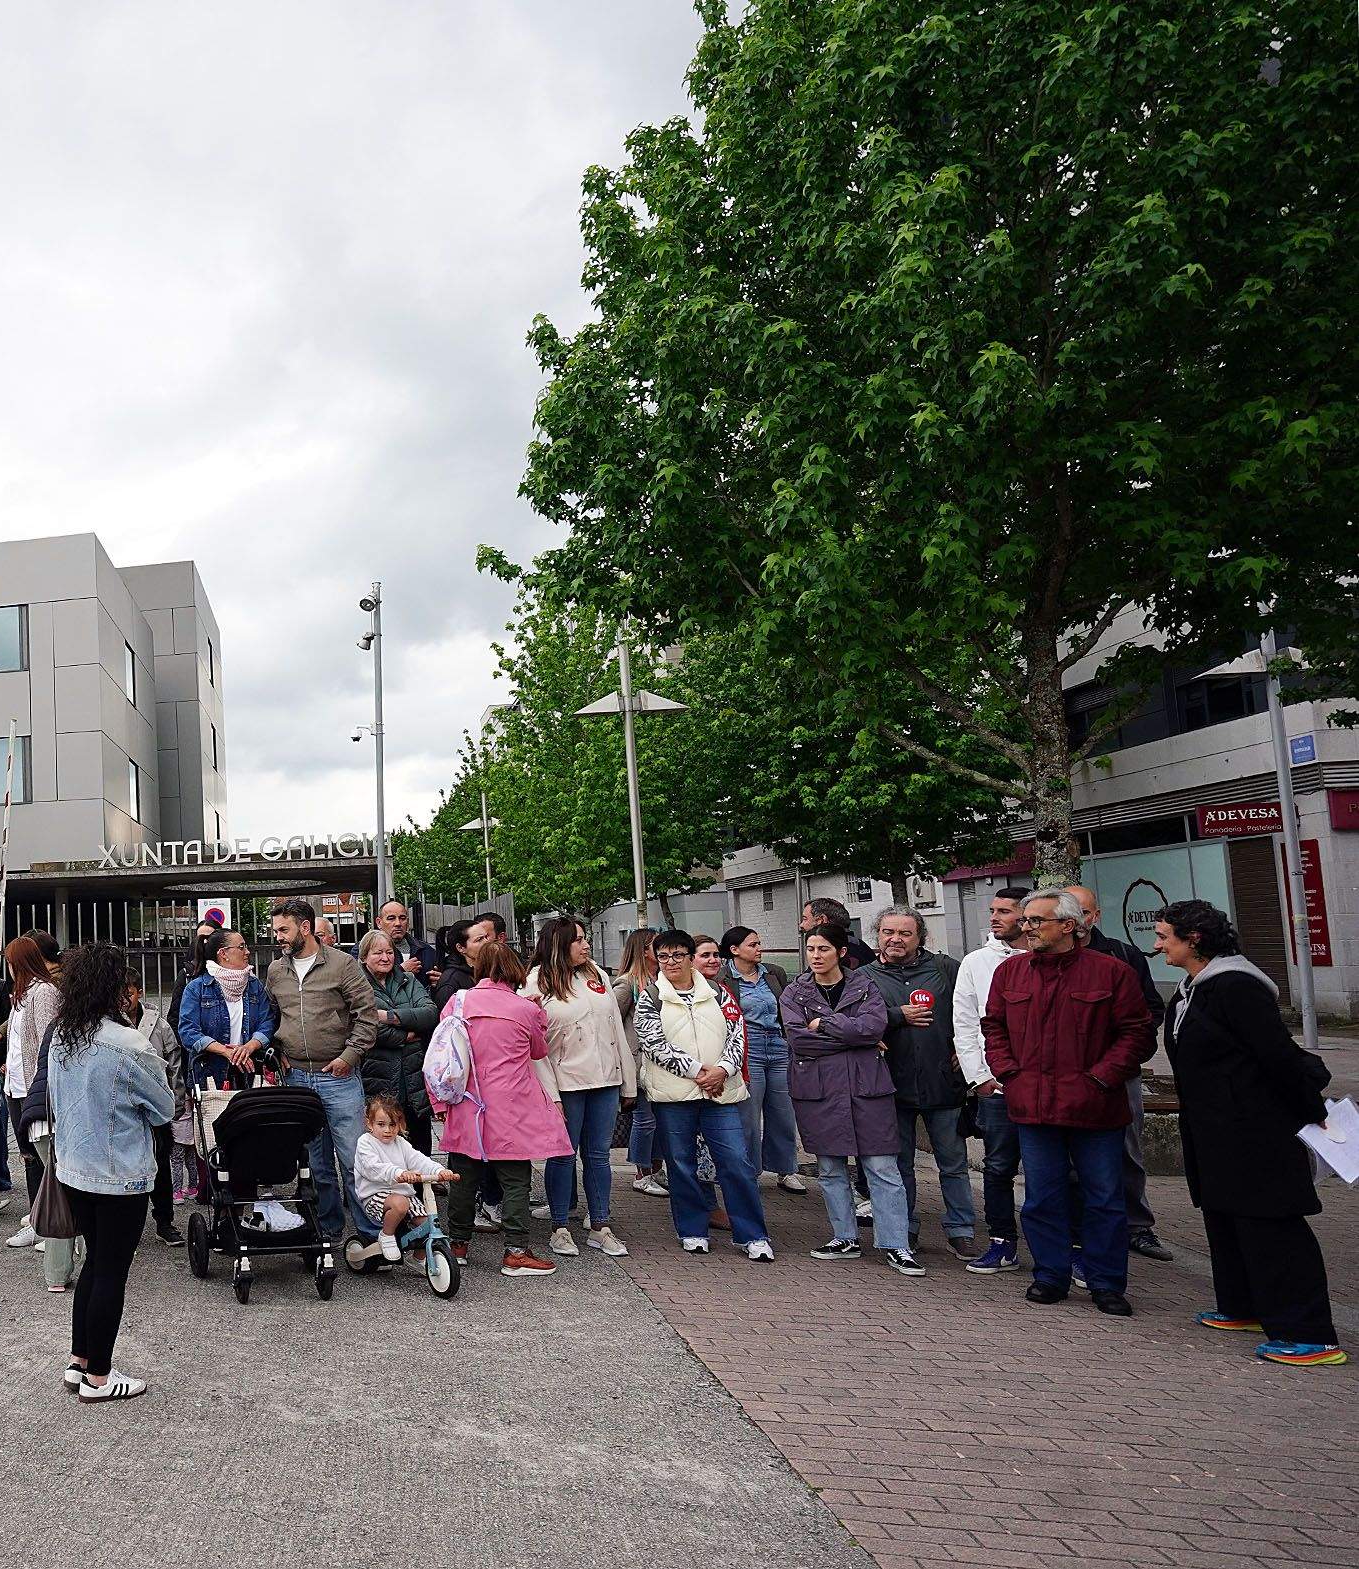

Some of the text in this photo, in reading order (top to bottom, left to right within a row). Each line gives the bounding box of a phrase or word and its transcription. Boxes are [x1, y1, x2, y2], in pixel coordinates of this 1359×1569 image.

[98, 831, 392, 868] XUNTA DE GALICIA
